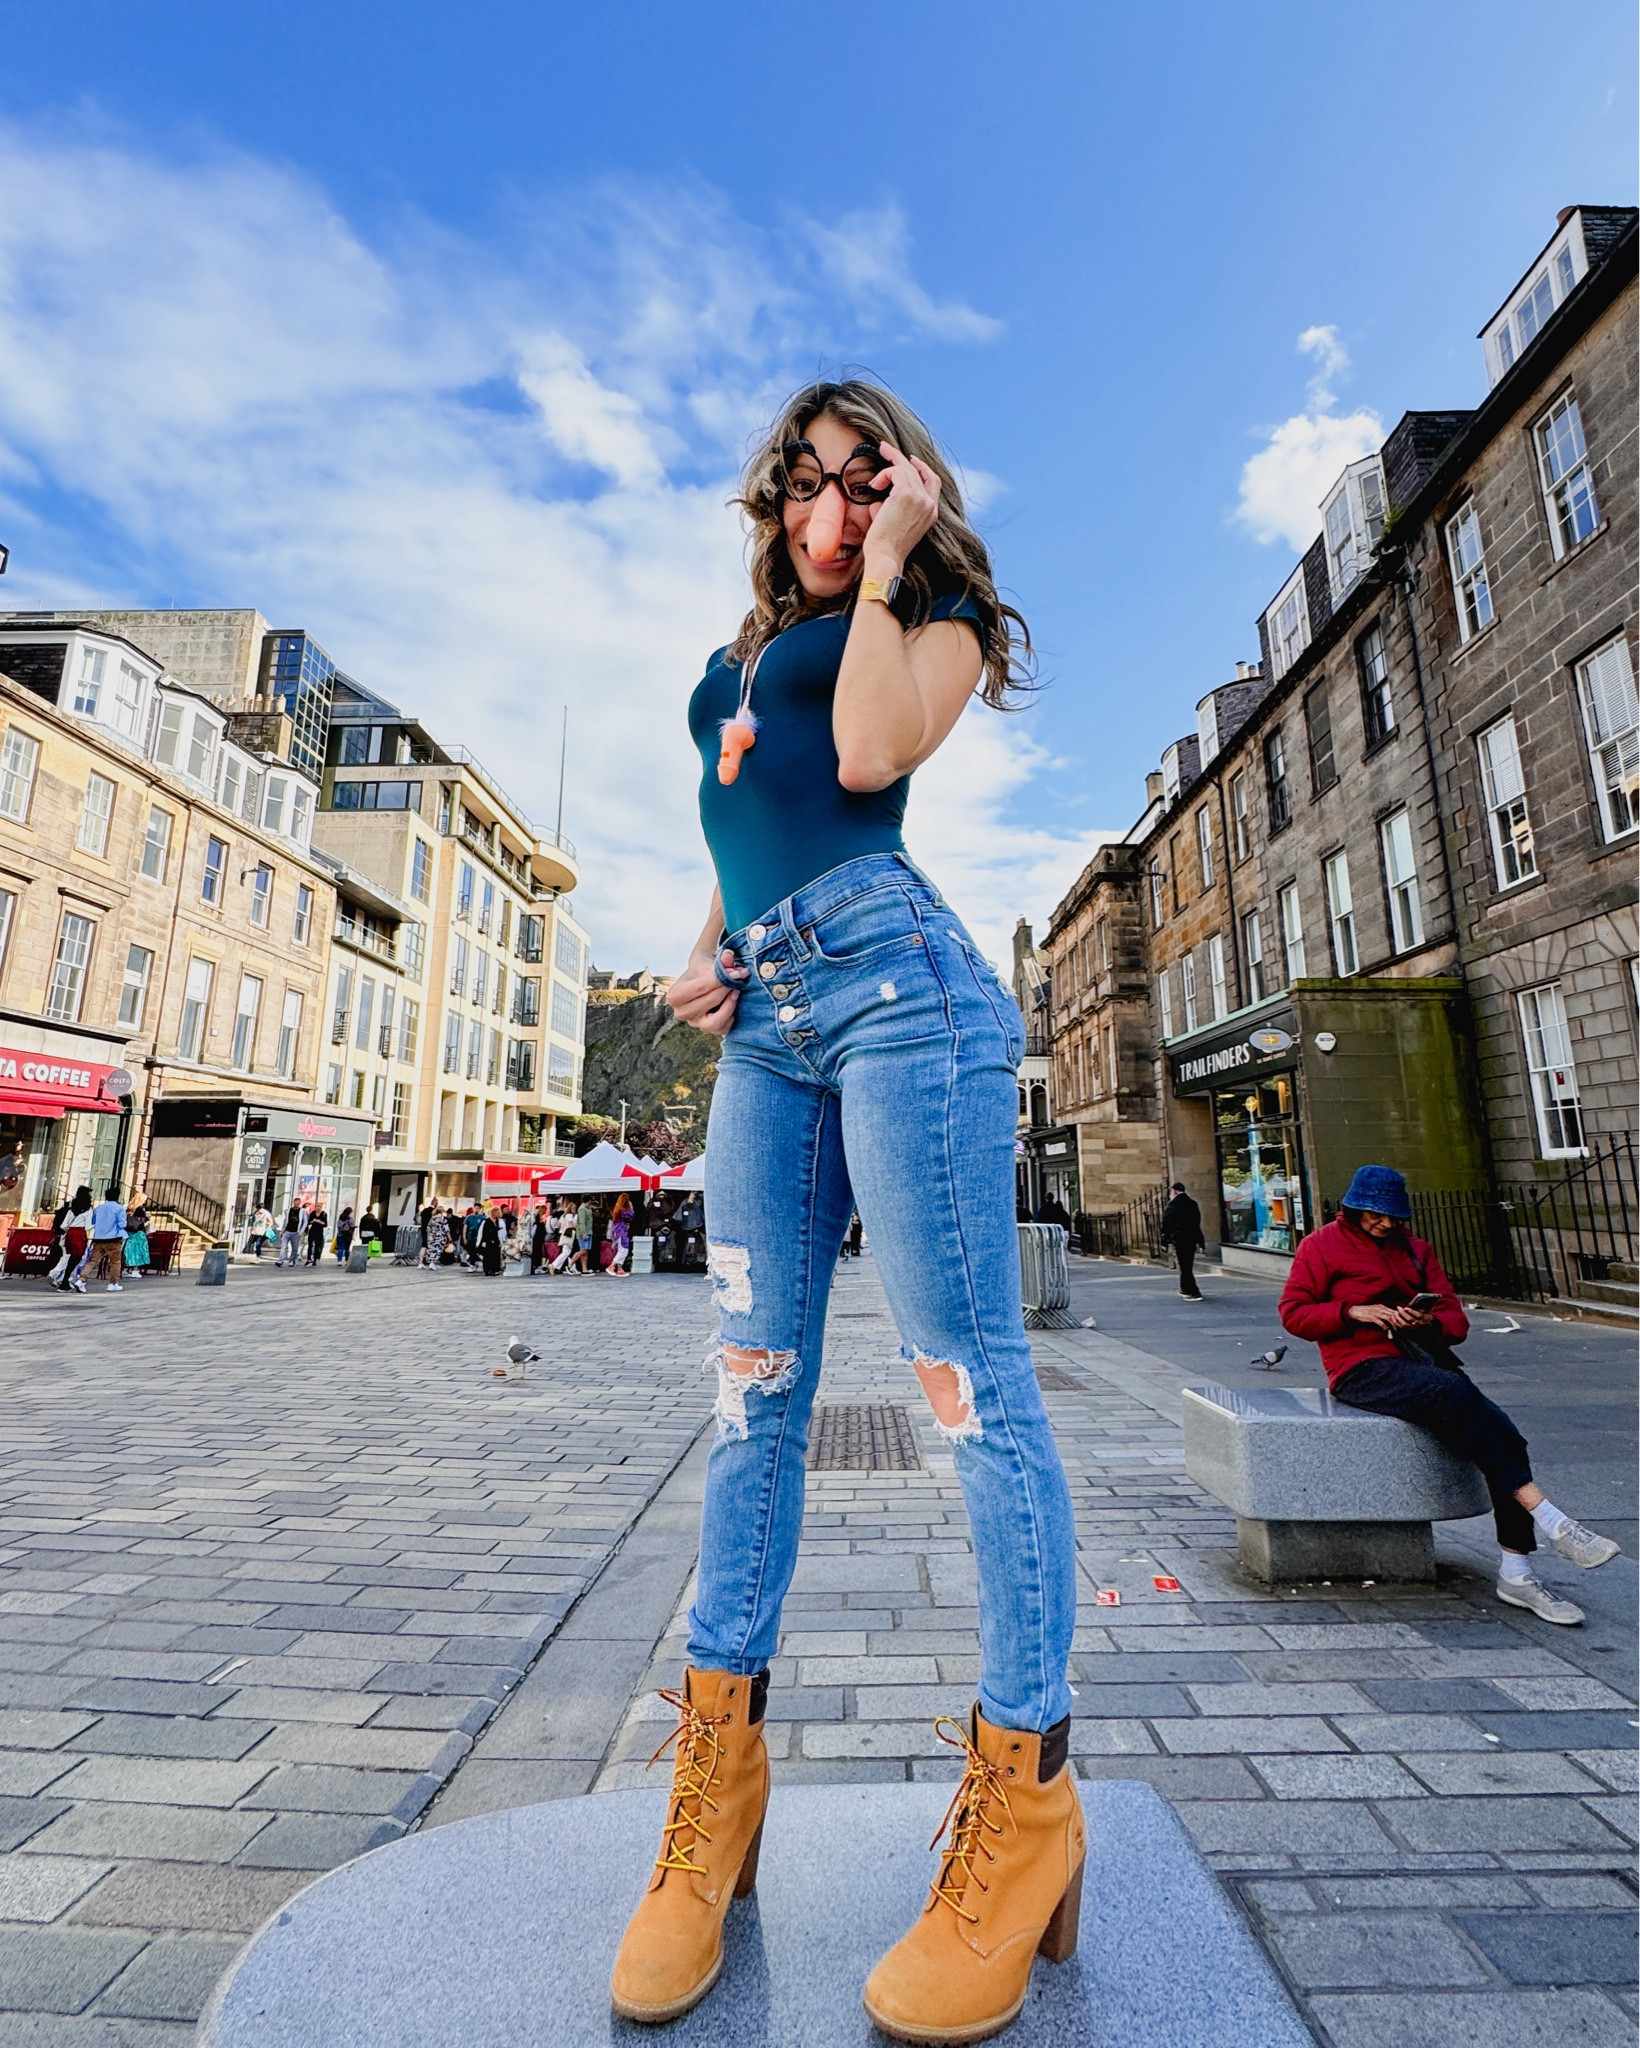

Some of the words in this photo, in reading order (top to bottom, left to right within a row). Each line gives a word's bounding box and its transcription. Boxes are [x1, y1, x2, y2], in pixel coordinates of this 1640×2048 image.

[1179, 1042, 1250, 1082] TRAILFINDERS
[22, 1062, 91, 1088] COFFEE
[108, 1077, 130, 1085] COSTA
[245, 1155, 266, 1165] CASTLE
